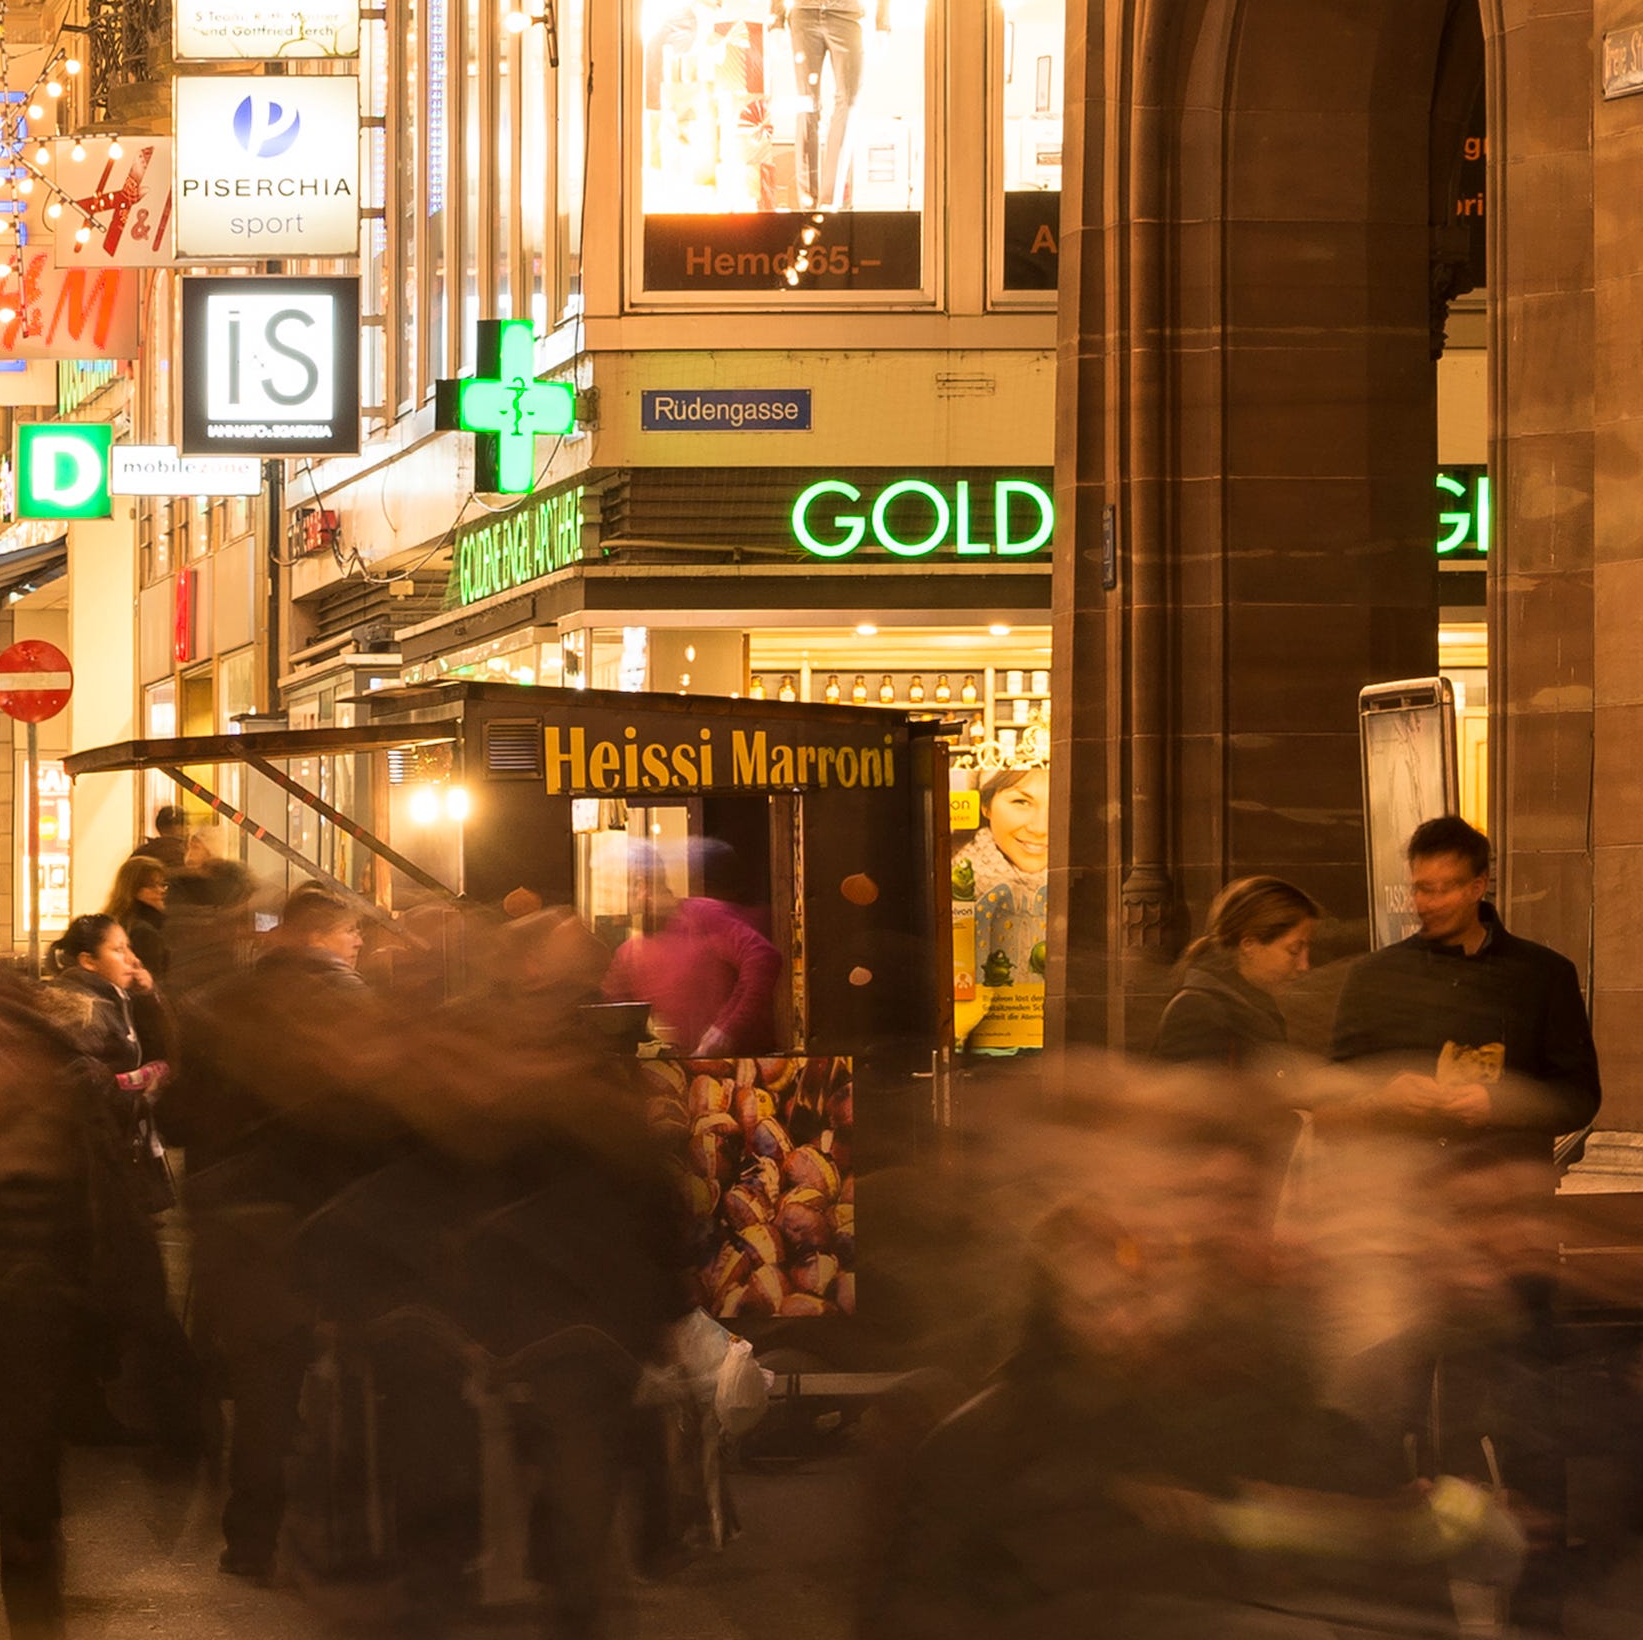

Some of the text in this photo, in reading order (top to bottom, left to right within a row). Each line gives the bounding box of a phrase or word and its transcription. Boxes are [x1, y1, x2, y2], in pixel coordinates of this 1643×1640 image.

[183, 178, 351, 197] PISERCHIA
[230, 214, 304, 238] sport
[685, 242, 796, 276] Hemd
[654, 396, 800, 427] Rüdengasse
[123, 459, 250, 475] mobilezone
[791, 479, 1055, 558] GOLD
[459, 521, 502, 606] GOLDENE
[502, 509, 533, 589] ENGEL
[545, 725, 895, 796] Heissi Marroni
